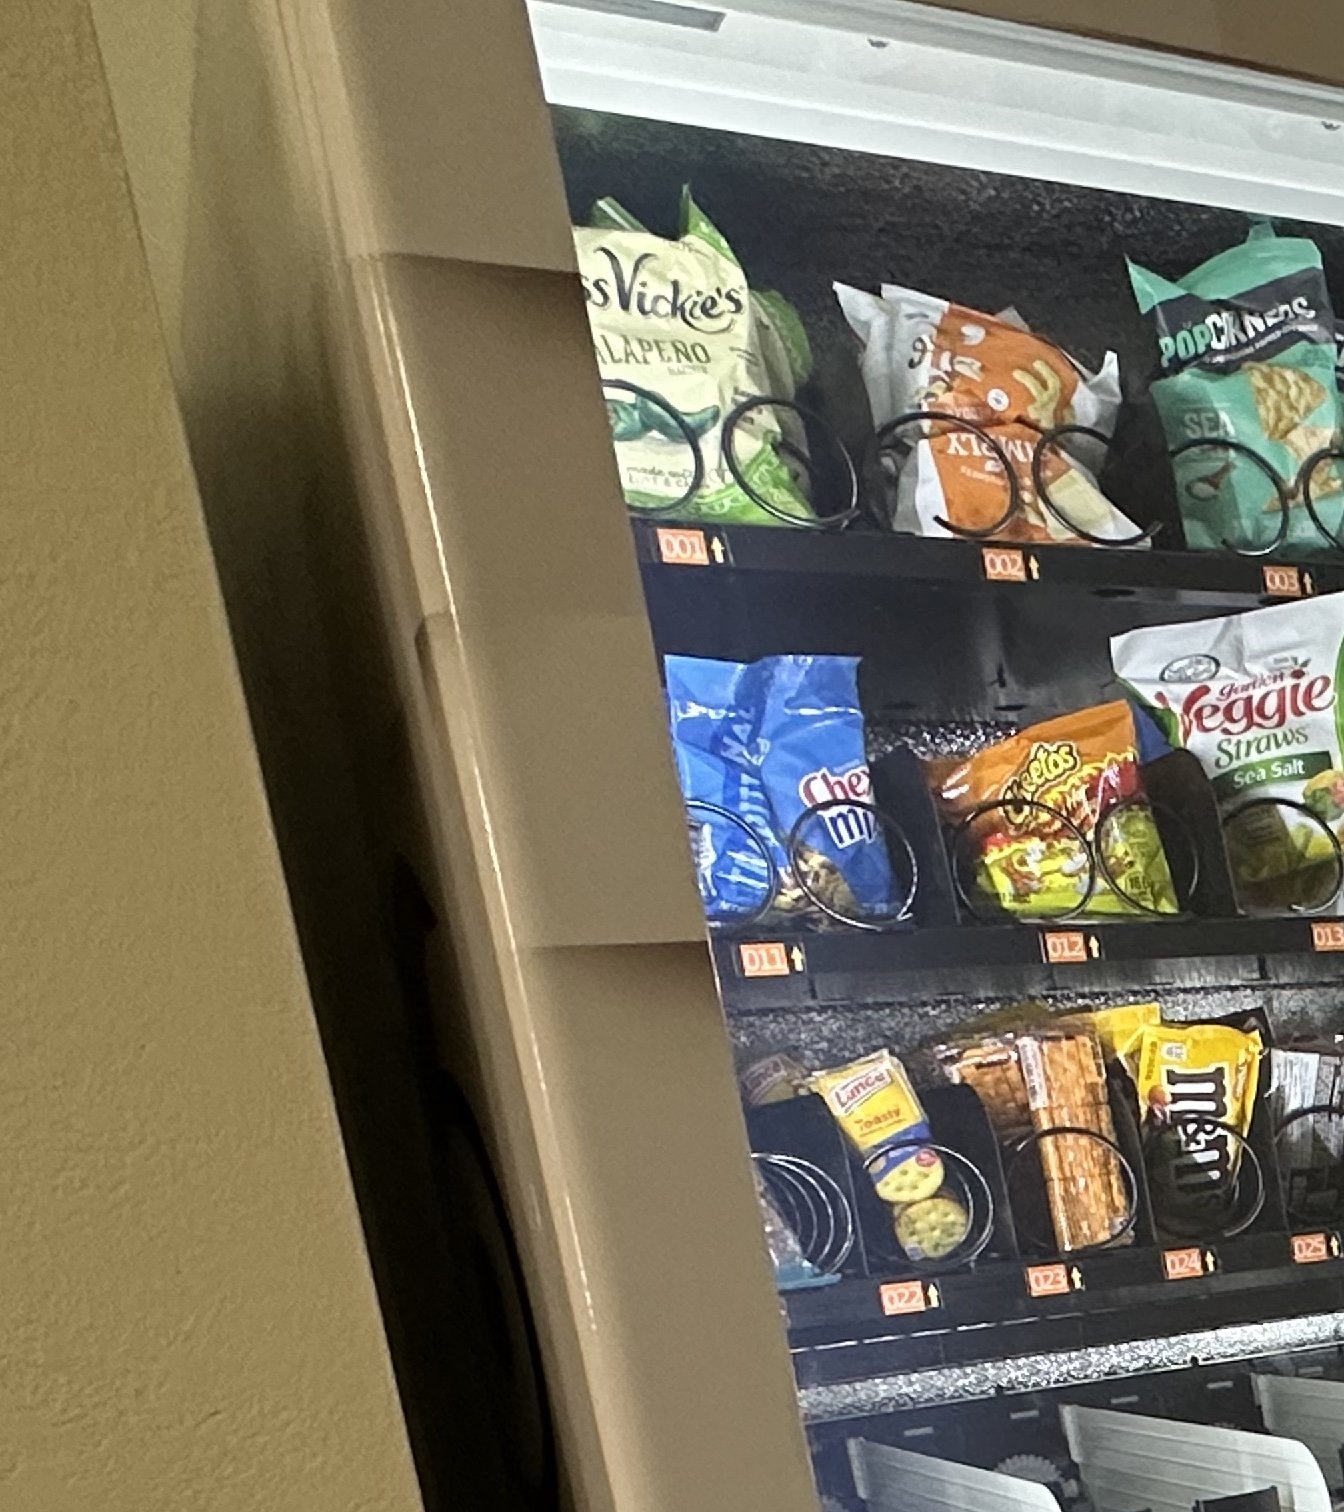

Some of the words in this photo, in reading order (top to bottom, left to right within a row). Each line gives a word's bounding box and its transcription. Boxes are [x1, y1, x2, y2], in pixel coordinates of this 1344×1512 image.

[593, 246, 745, 334] Vickie's
[1184, 411, 1235, 438] SEA
[947, 432, 1044, 463] IMPLY
[662, 532, 704, 560] 001
[984, 552, 1023, 578] 002
[1267, 570, 1298, 593] 003
[1155, 675, 1336, 741] Veggie
[1214, 726, 1310, 769] Straws
[1003, 743, 1080, 827] Cheetos
[1233, 767, 1267, 789] Sea
[1270, 758, 1306, 779] Salt
[743, 948, 785, 973] 011
[1047, 937, 1085, 960] 012
[833, 1067, 887, 1109] Lance
[855, 1105, 901, 1132] Toasty
[1296, 1236, 1327, 1257] 025
[1165, 1252, 1202, 1276] 024
[1031, 1268, 1068, 1291] 023
[884, 1286, 923, 1312] 022
